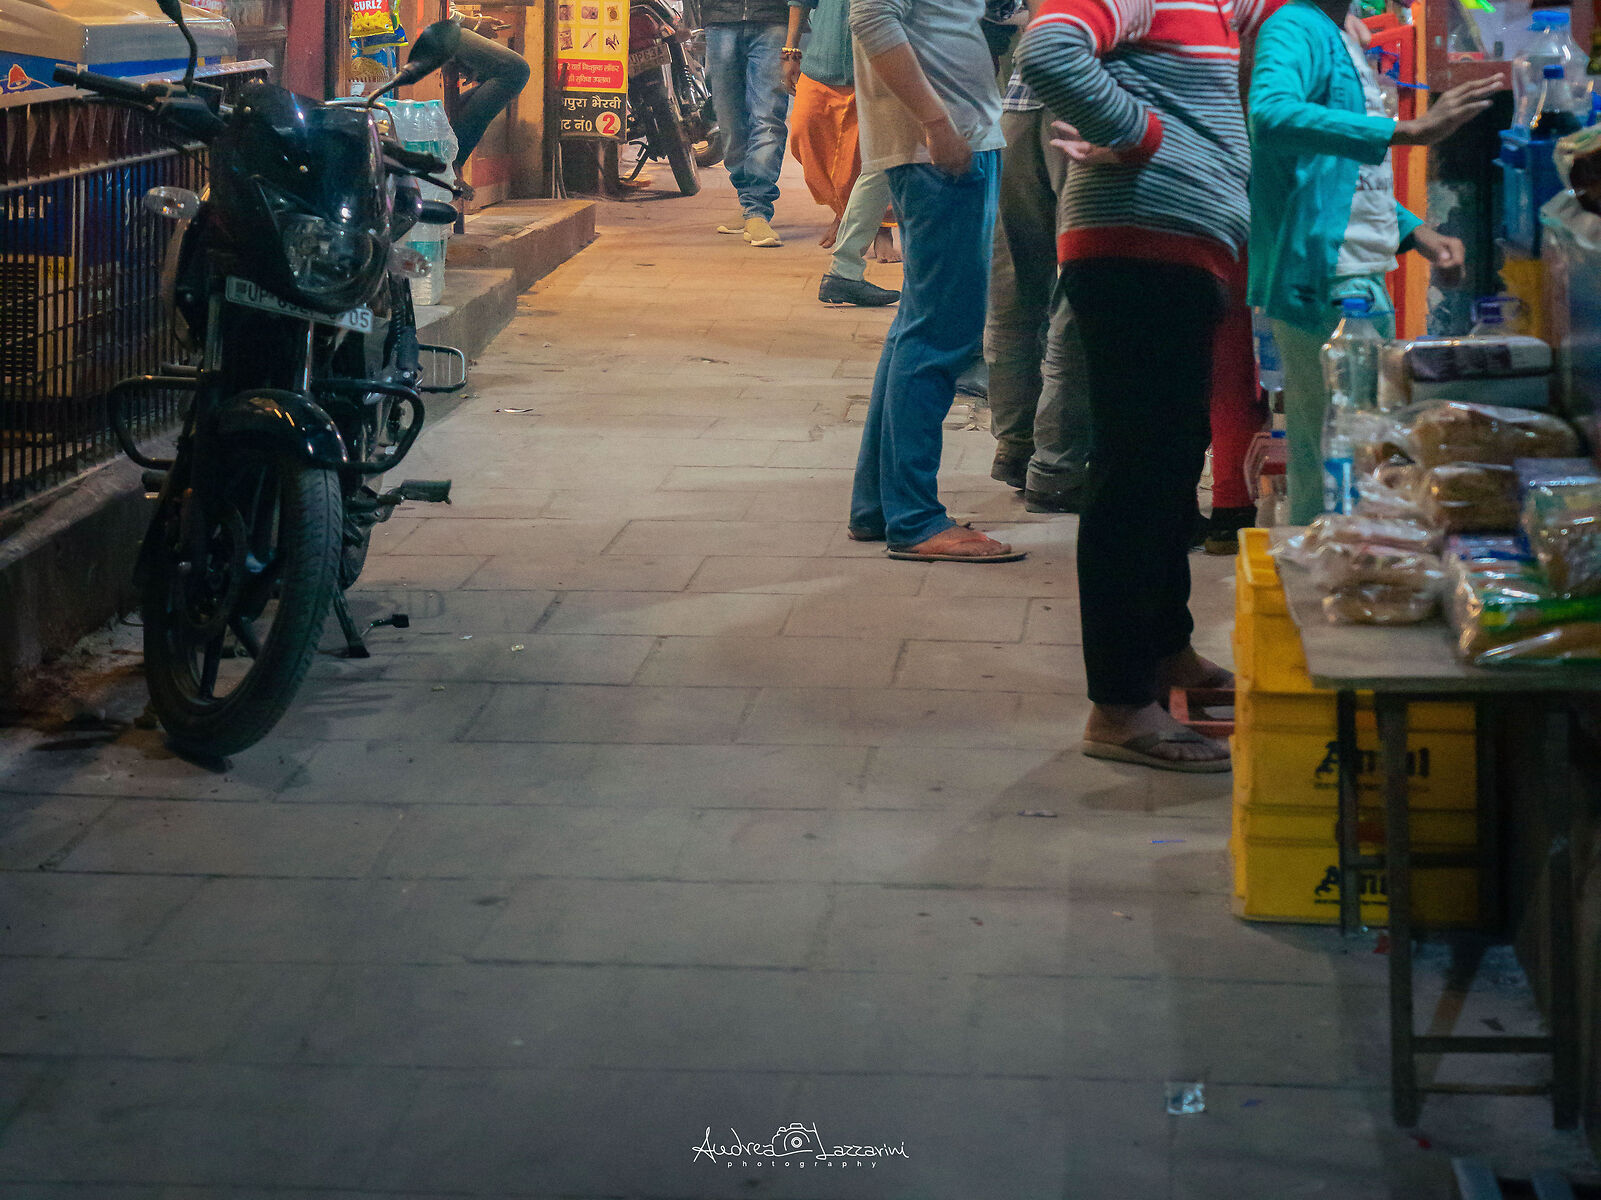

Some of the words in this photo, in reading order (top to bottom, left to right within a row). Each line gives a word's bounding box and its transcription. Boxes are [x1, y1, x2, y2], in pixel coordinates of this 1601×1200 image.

[353, 0, 383, 12] CURLZ
[592, 95, 622, 109] भैरवी
[602, 114, 615, 134] 2
